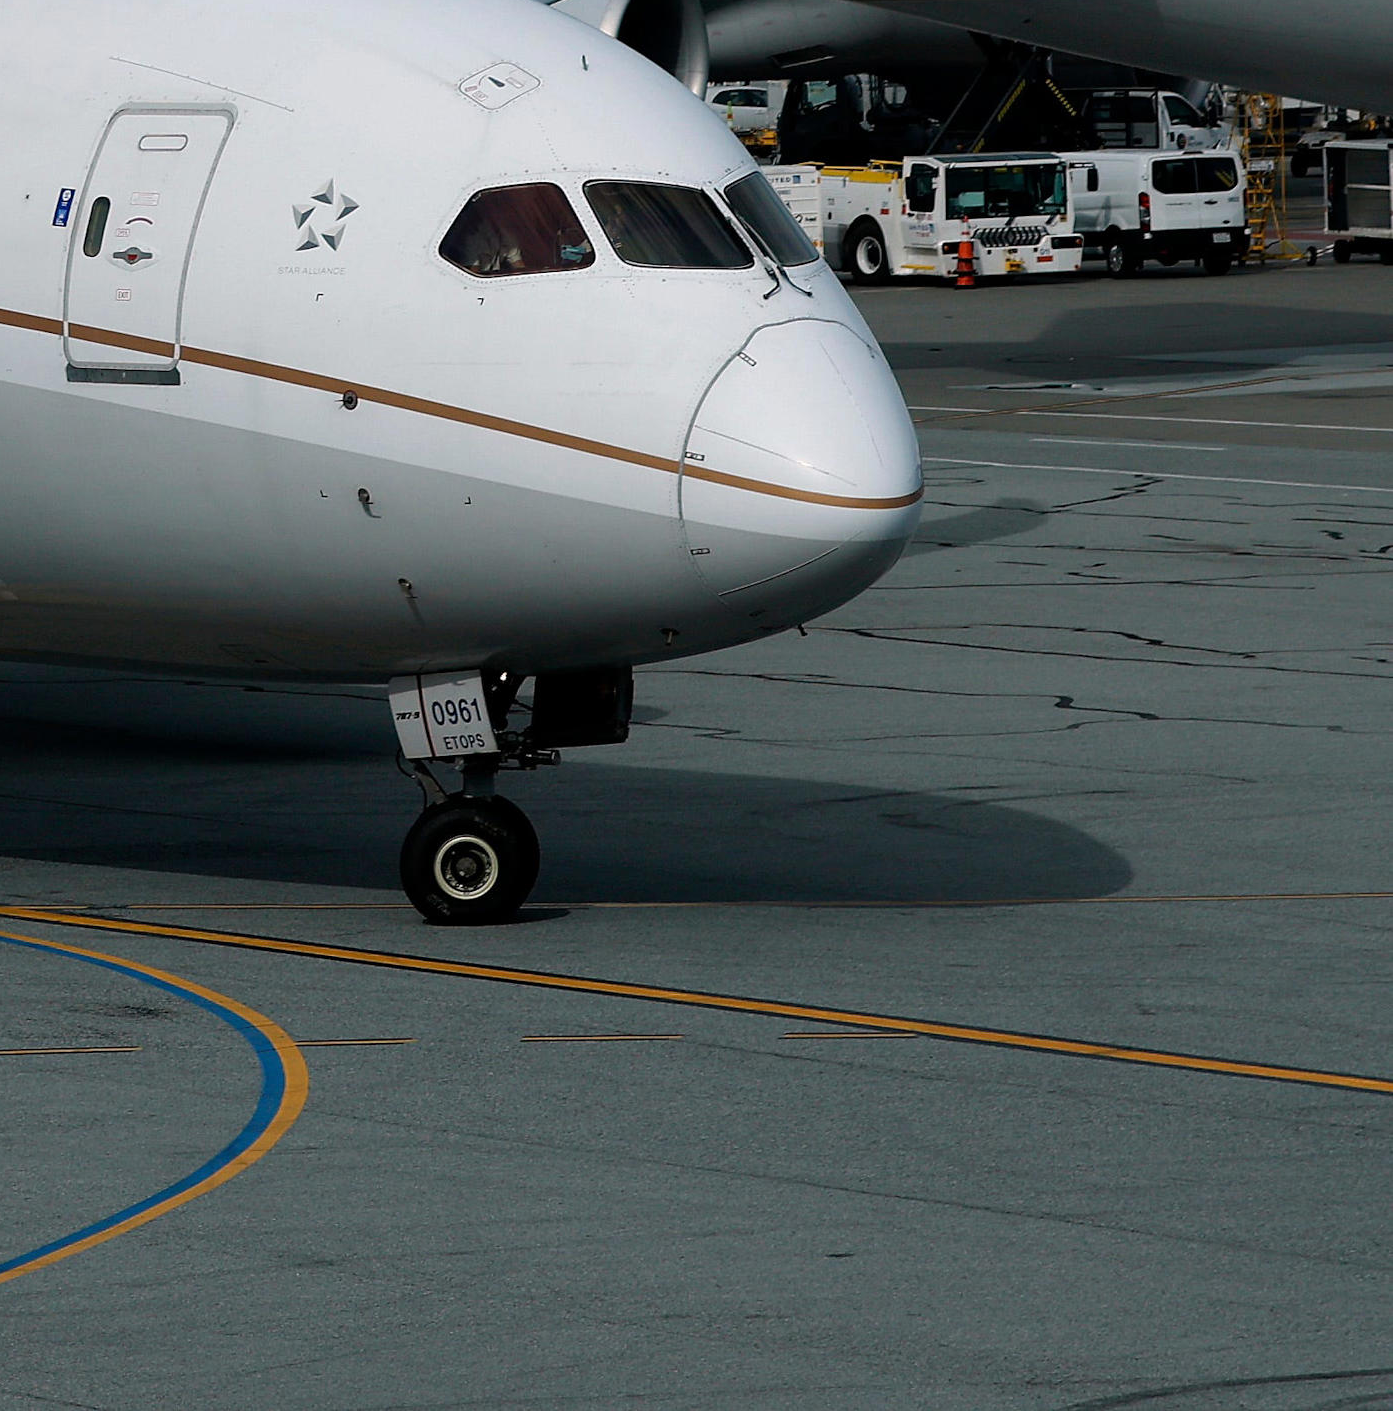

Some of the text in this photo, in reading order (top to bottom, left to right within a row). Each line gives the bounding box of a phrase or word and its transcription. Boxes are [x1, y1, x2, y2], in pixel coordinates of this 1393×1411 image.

[277, 267, 347, 276] STAR ALLIANCE
[431, 697, 482, 726] 0961
[443, 733, 486, 750] ETOPS
